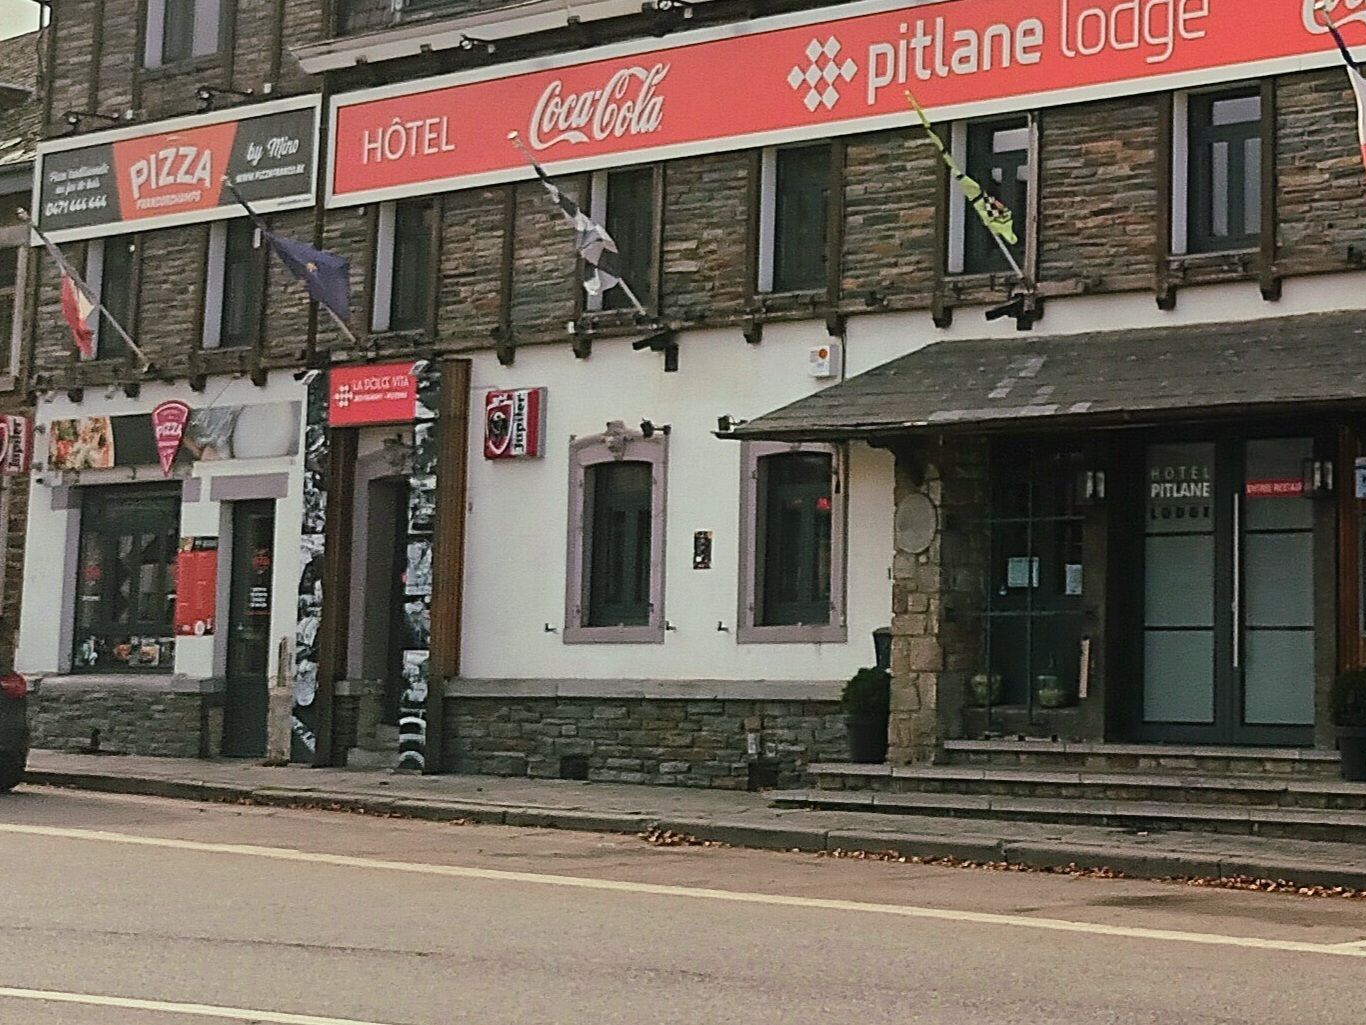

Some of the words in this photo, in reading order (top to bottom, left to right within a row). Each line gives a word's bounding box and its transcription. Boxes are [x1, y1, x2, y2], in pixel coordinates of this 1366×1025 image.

[867, 17, 1043, 106] pitlane
[530, 62, 671, 151] Coca-Cola
[246, 142, 263, 166] by
[362, 117, 456, 165] HÔTEL
[130, 146, 212, 201] PIZZA
[514, 392, 526, 452] Jupiler
[1151, 483, 1211, 498] PITLANE
